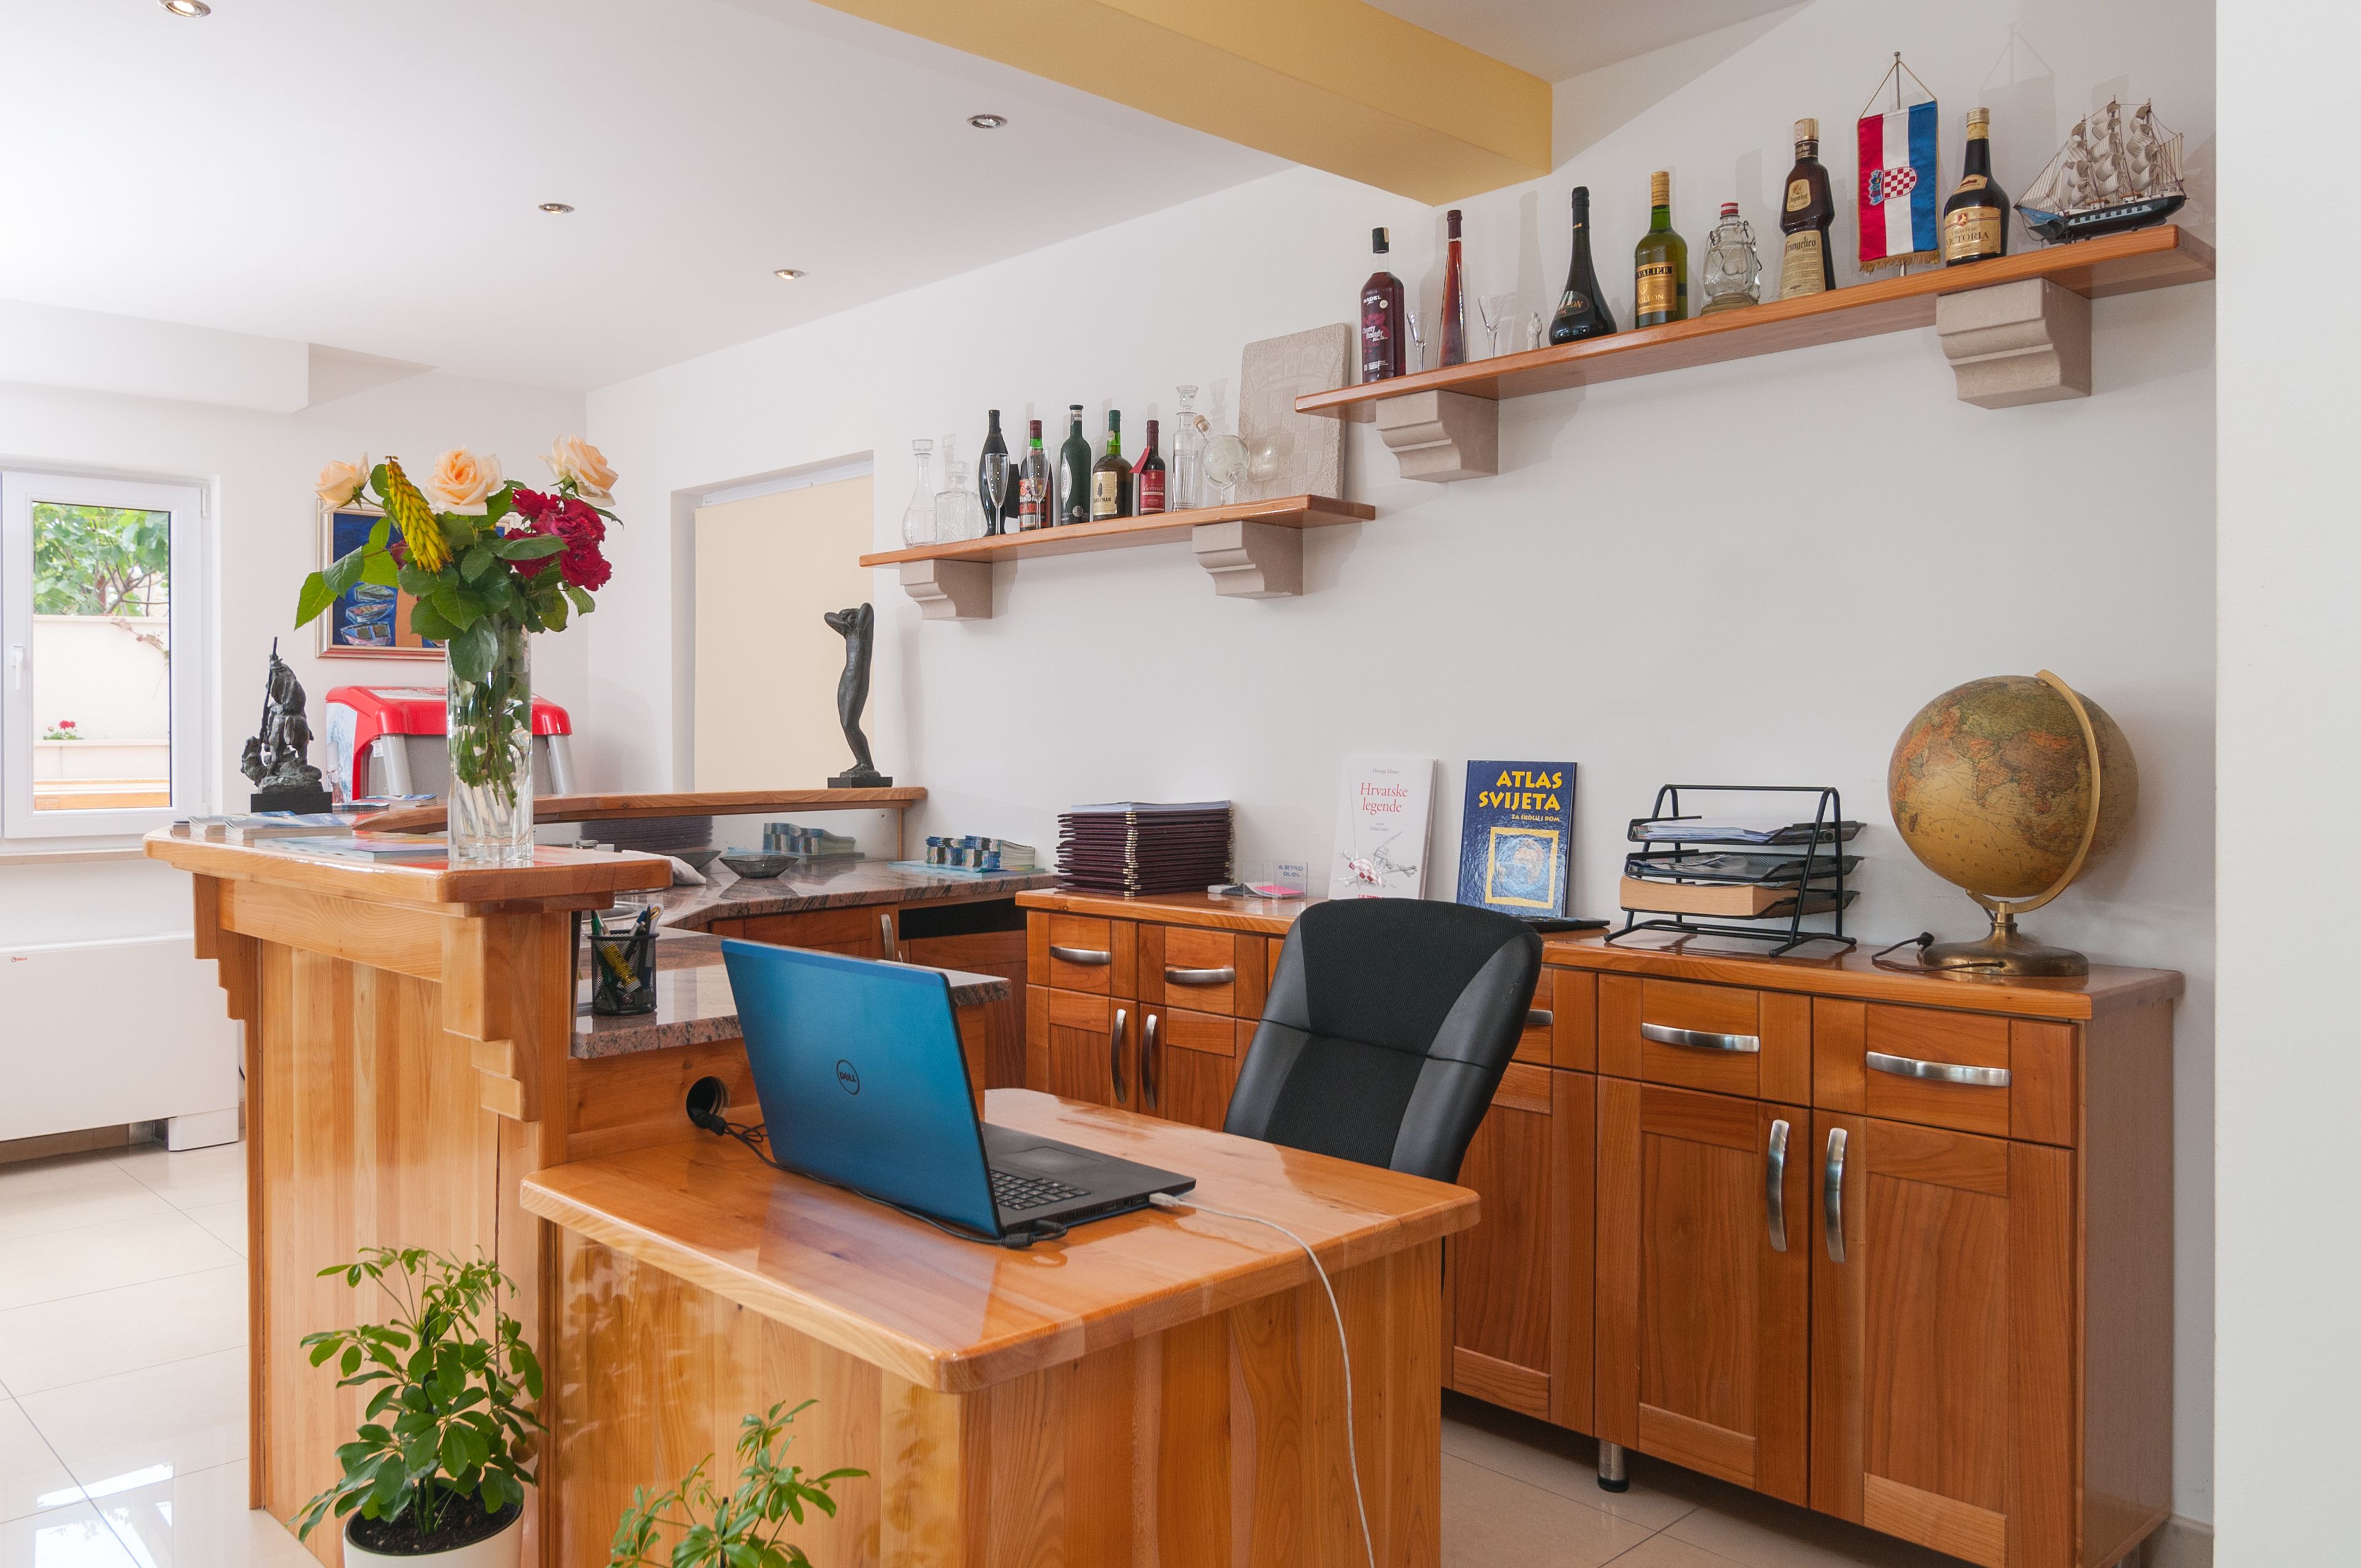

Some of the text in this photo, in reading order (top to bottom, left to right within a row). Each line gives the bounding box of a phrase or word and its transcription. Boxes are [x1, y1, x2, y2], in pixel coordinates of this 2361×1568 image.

[1496, 770, 1562, 789] ATLAS
[1360, 782, 1408, 797] Hrvatske
[1362, 797, 1402, 815] legende
[1479, 791, 1560, 811] SVIJETA
[839, 1072, 857, 1083] DELL
